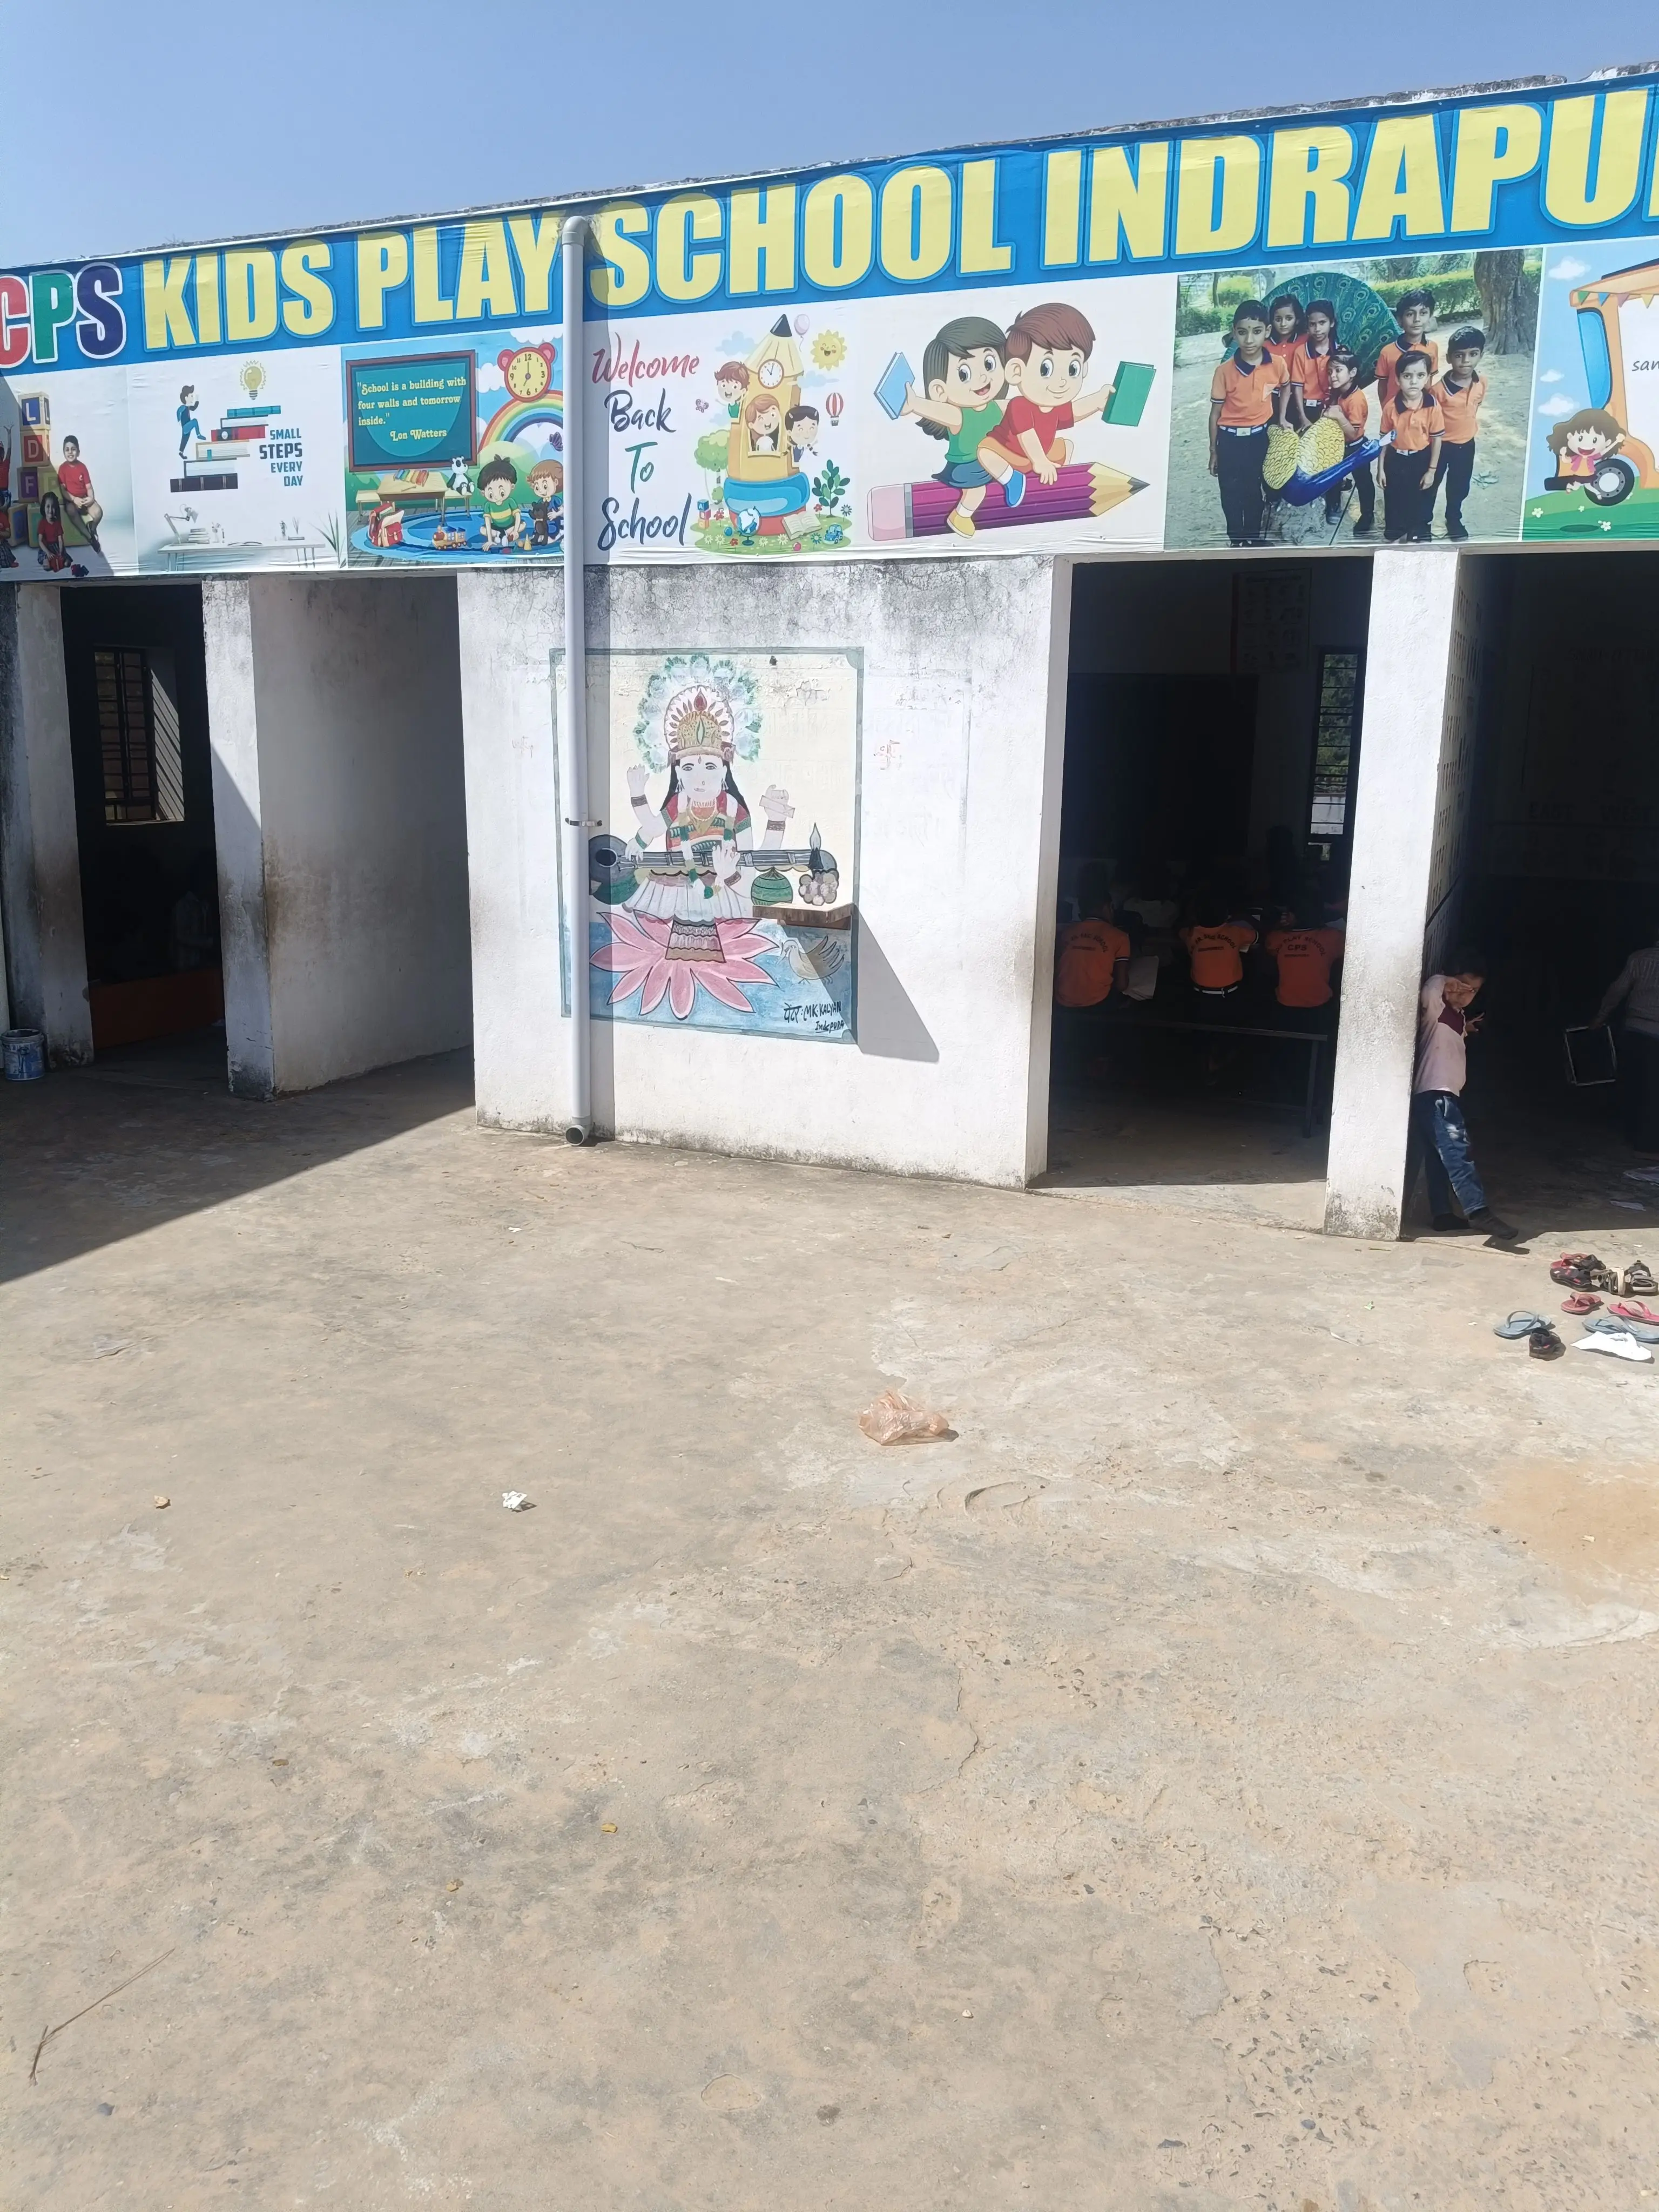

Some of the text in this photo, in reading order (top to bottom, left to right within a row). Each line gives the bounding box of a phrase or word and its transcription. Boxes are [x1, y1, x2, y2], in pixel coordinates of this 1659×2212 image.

[0, 87, 1659, 368] CPS KIDS PLAY SCHOOL INDRAPU
[524, 353, 532, 361] 12
[592, 332, 700, 388] Welcome
[392, 382, 399, 392] is
[409, 379, 444, 389] building
[447, 376, 467, 387] with
[25, 402, 36, 421] L
[358, 396, 461, 409] four walls and tomorrow
[604, 387, 677, 433] Back
[269, 428, 301, 440] SMALL
[390, 429, 447, 441] Lon Watters
[27, 439, 39, 458] D
[259, 442, 302, 460] STEPS
[271, 461, 302, 473] EVERY
[624, 441, 658, 494] To
[25, 476, 35, 494] F
[284, 475, 303, 487] DAY
[597, 492, 692, 551] School
